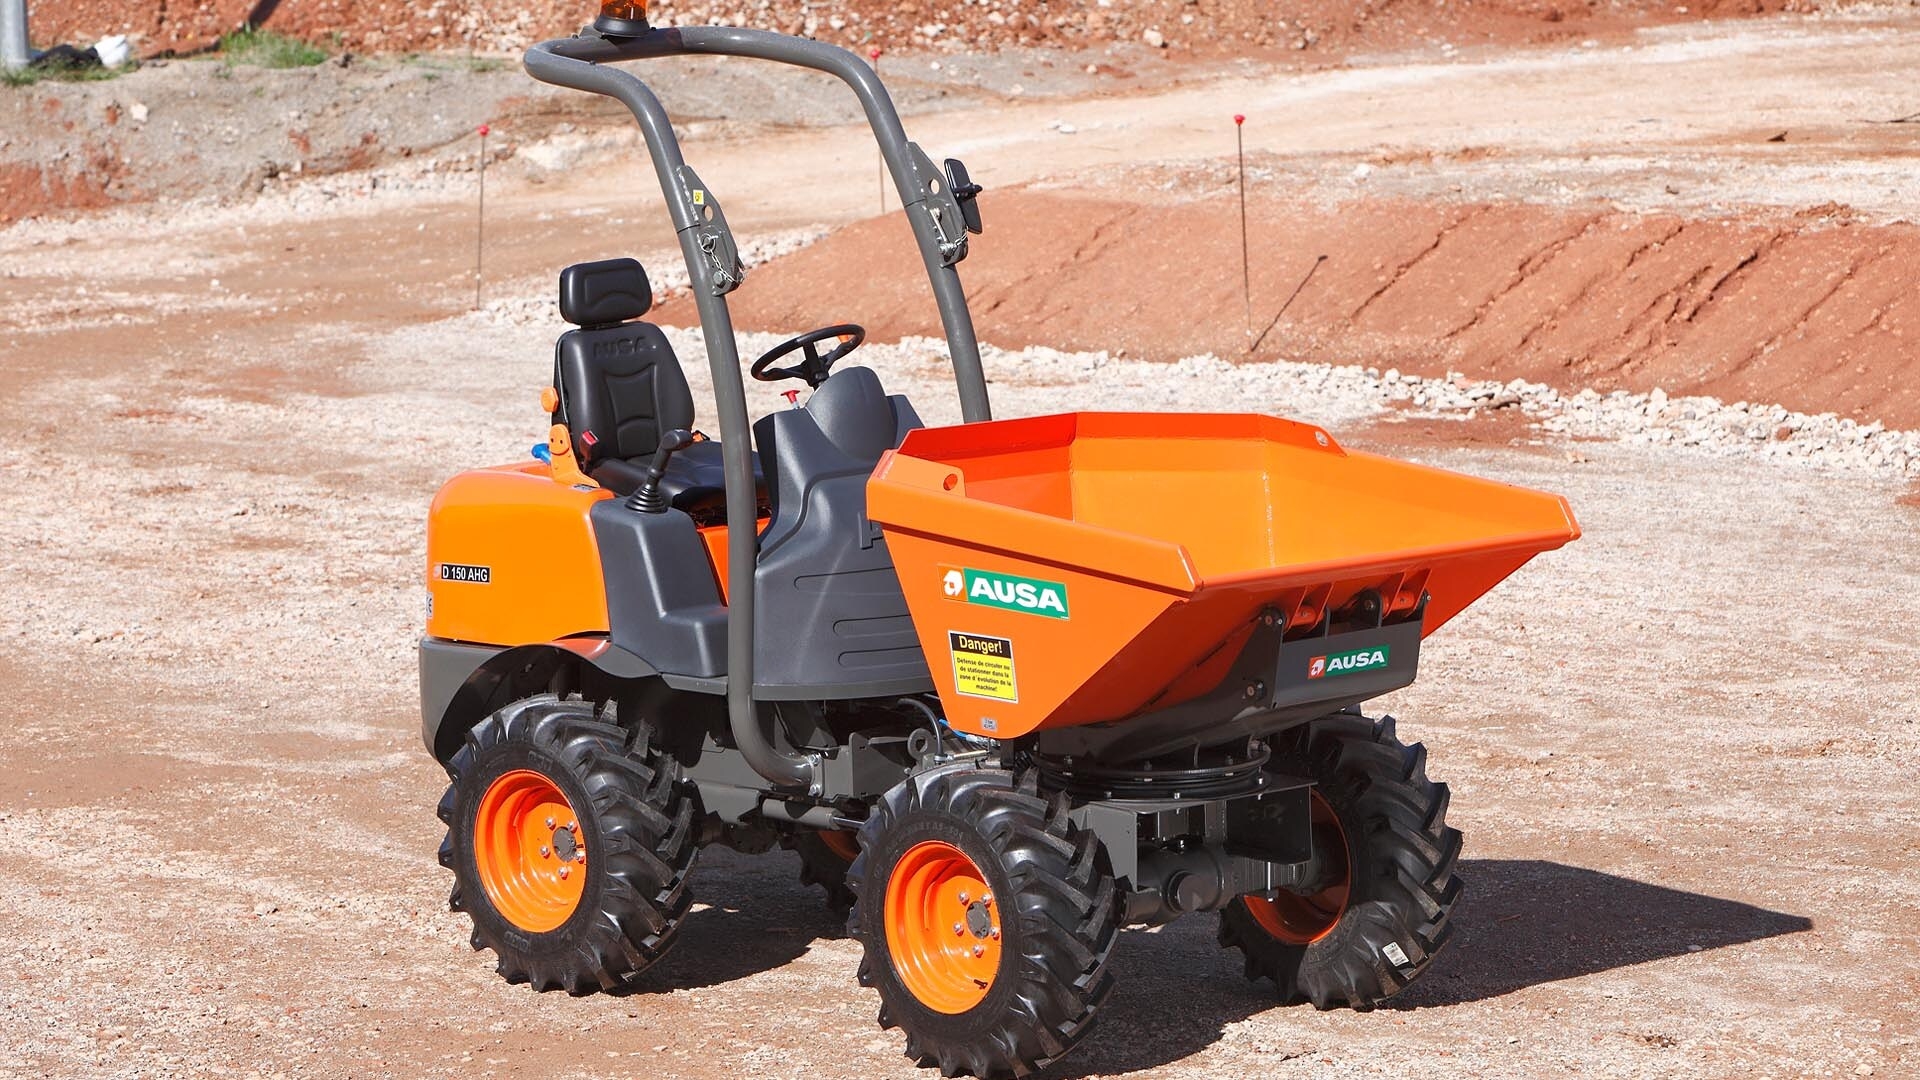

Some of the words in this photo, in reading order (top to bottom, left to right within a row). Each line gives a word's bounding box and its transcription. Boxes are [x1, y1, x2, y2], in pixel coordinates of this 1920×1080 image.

[442, 565, 449, 579] D
[451, 566, 466, 580] 150
[467, 568, 488, 582] AHG
[970, 577, 1066, 612] AUSA
[958, 635, 1003, 655] Danger!
[1326, 651, 1385, 672] AUSA
